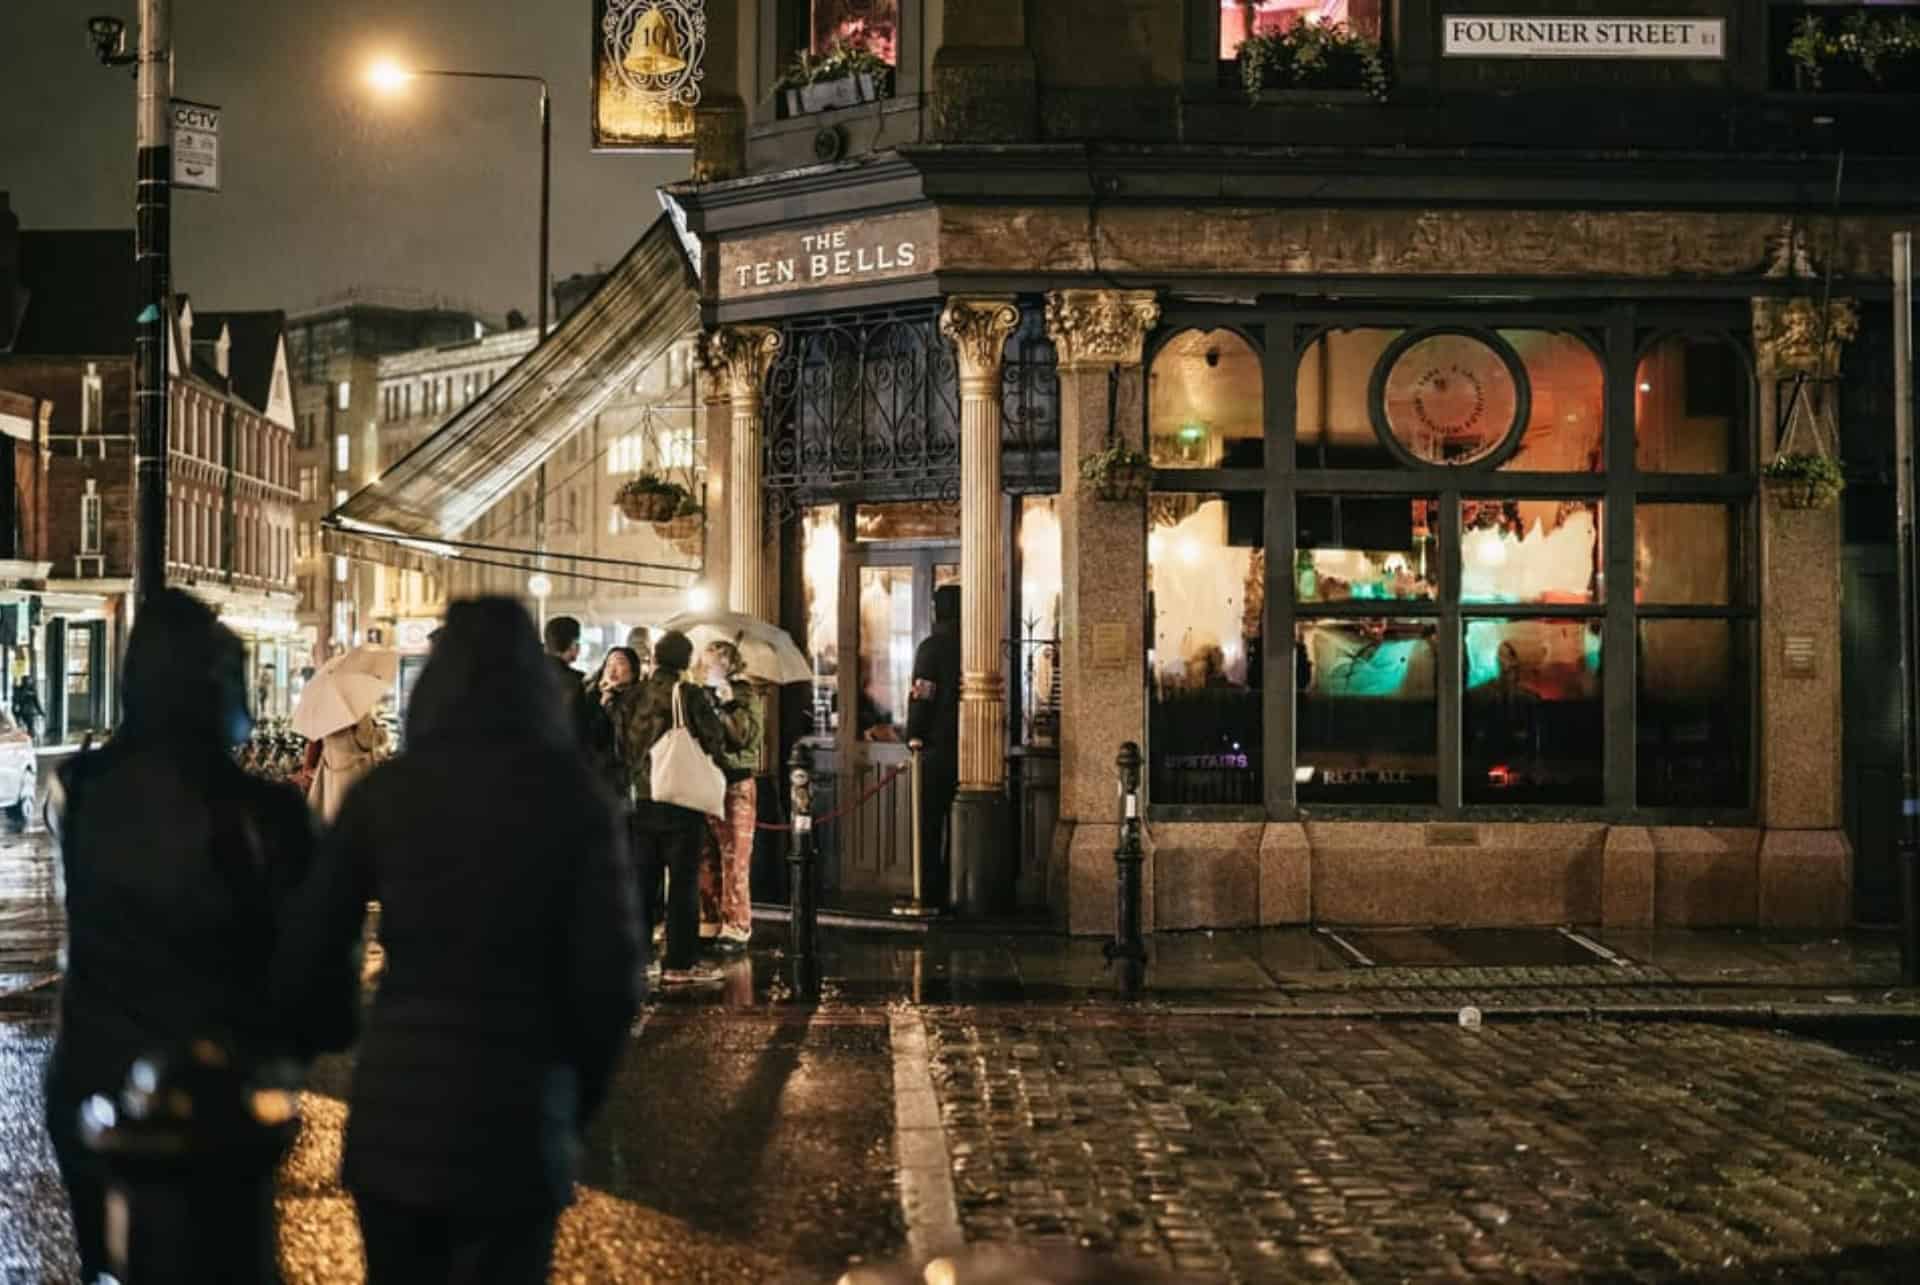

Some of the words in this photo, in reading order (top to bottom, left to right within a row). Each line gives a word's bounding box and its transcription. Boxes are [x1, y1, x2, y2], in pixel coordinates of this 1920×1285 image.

[1453, 21, 1588, 43] FOURNIER
[1596, 23, 1694, 45] STREET
[175, 110, 217, 128] CCTV
[801, 231, 847, 251] THE
[736, 259, 794, 287] TEN
[811, 243, 915, 277] BELLS
